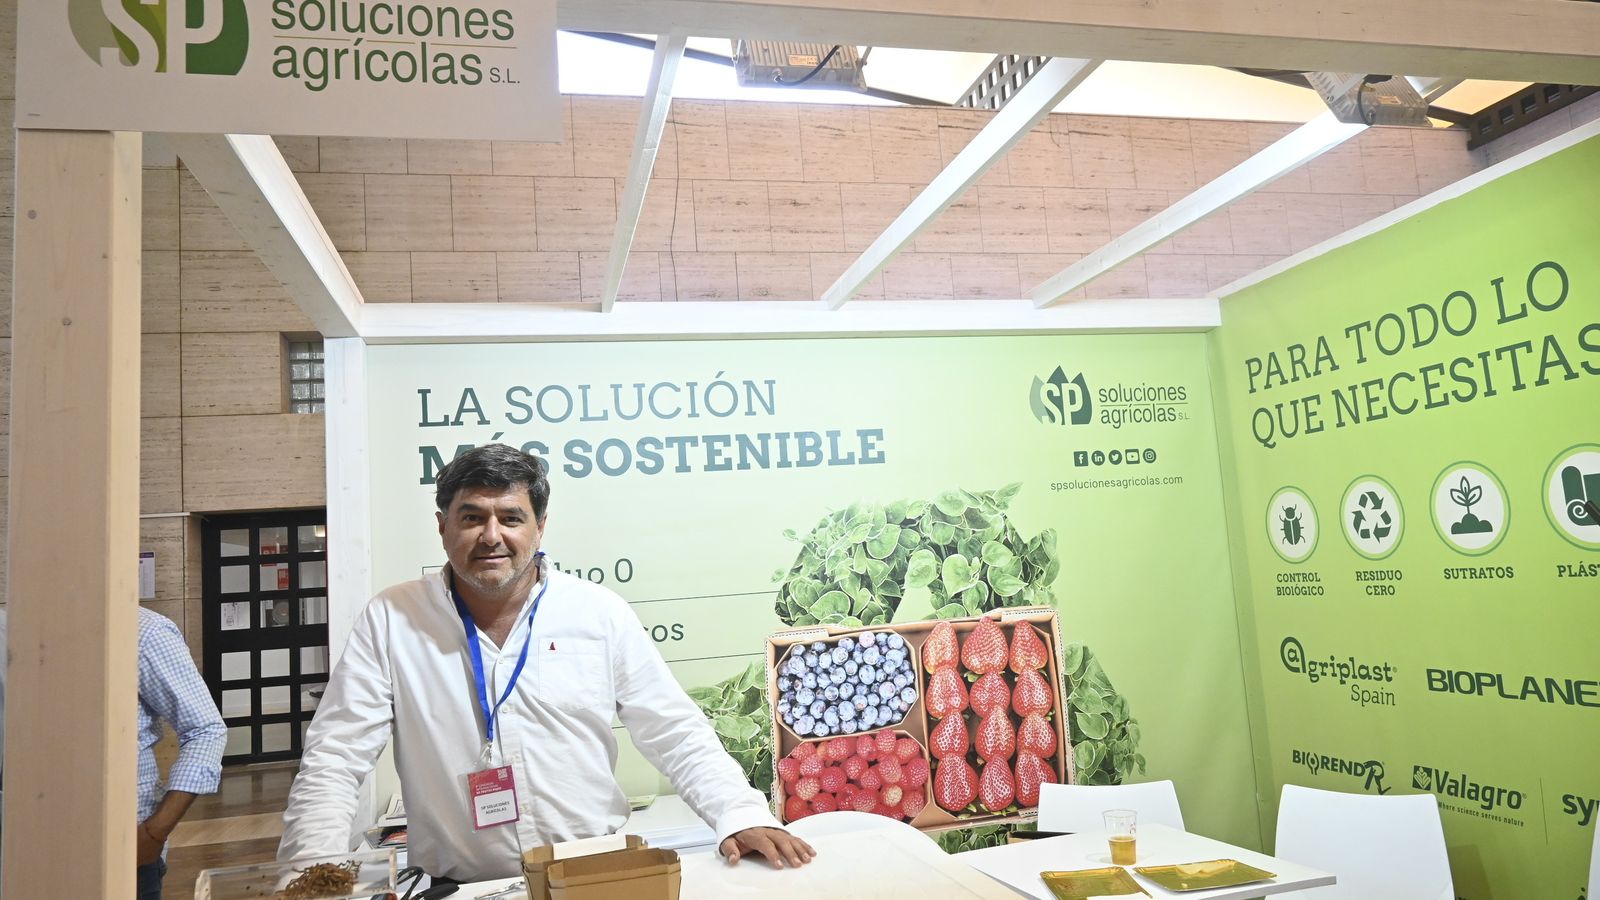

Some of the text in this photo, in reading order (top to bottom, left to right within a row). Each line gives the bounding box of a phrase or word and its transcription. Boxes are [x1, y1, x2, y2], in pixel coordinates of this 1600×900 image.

[271, 0, 514, 41] soluciones
[273, 39, 521, 91] agrícolas S.L.
[1245, 261, 1570, 394] PARA TODO LO
[418, 371, 776, 427] LA SOLUCIÓN
[1098, 383, 1187, 403] soluciones
[1252, 323, 1600, 449] QUE NECESITAS
[1039, 382, 1084, 425] SP
[1101, 404, 1177, 429] agrícolas
[563, 428, 886, 479] SOSTENIBLE
[1050, 476, 1183, 492] spsolucionesagricolas.com
[1276, 572, 1321, 583] CONTROL
[1355, 570, 1403, 581] RESIDUO
[1443, 566, 1514, 579] SUTRATOS
[1556, 561, 1600, 577] PLÁS
[1365, 585, 1396, 596] CERO
[1351, 684, 1396, 707] Spain
[1426, 668, 1600, 708] BIOPLANE
[1435, 768, 1521, 810] Valagro
[1457, 806, 1479, 817] science
[1562, 794, 1600, 826] sy
